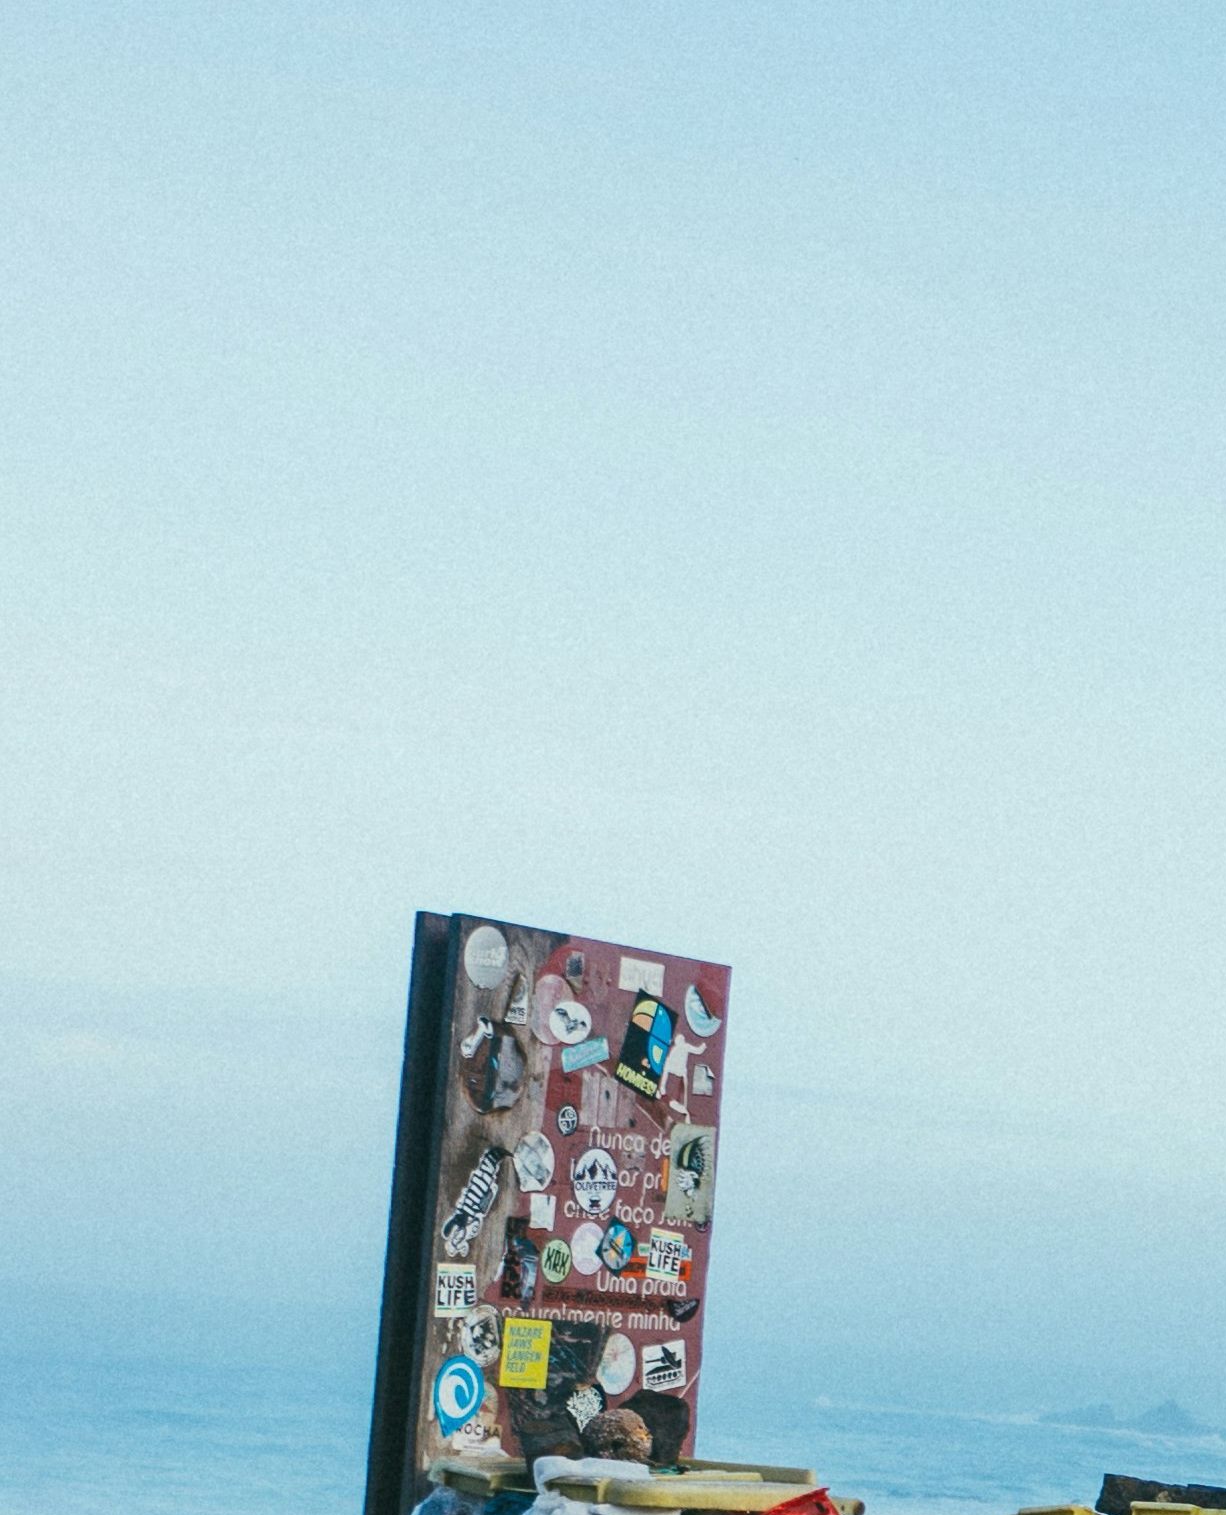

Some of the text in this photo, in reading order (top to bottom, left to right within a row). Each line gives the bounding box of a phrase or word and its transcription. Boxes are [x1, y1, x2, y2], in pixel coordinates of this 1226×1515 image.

[588, 1126, 645, 1153] Nunca
[575, 1181, 617, 1191] OLIVETREE
[615, 1199, 655, 1229] faço
[651, 1239, 682, 1257] KUSH
[649, 1252, 680, 1272] LIFE
[438, 1275, 475, 1289] KUSH
[596, 1271, 637, 1294] Uma
[437, 1289, 476, 1306] LIFE
[628, 1308, 681, 1331] minha
[457, 1423, 500, 1439] OCHA
